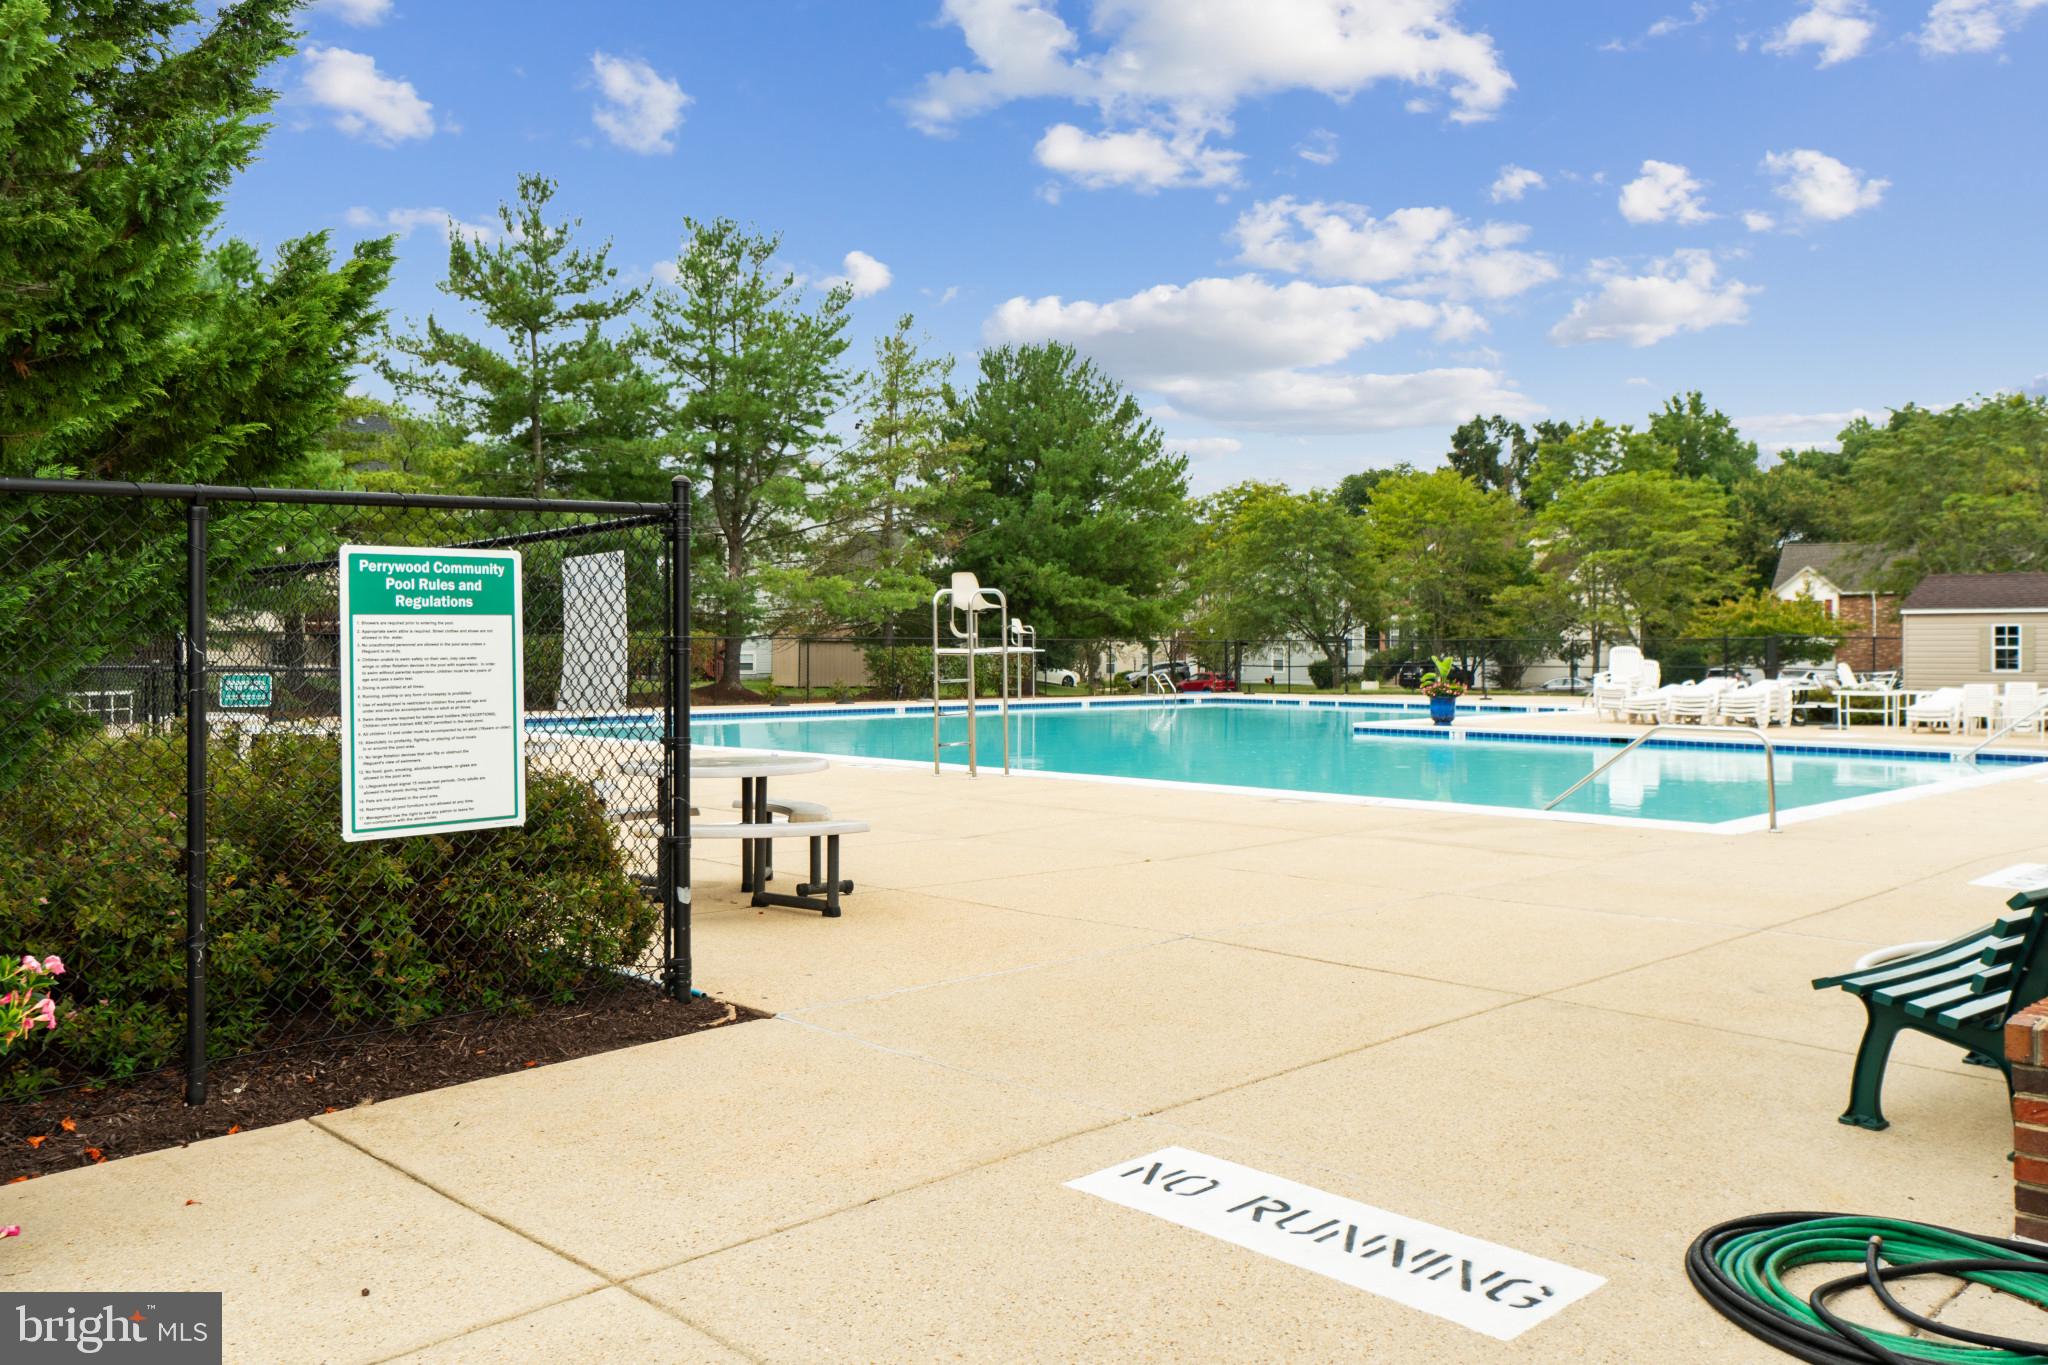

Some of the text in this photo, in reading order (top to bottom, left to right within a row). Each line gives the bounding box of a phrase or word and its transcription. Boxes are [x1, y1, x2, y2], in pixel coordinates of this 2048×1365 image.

[359, 559, 505, 577] Perrywood Community
[386, 577, 482, 591] Pool Rules and
[395, 595, 473, 609] Regulations
[1121, 1162, 1554, 1309] NO RUNNING
